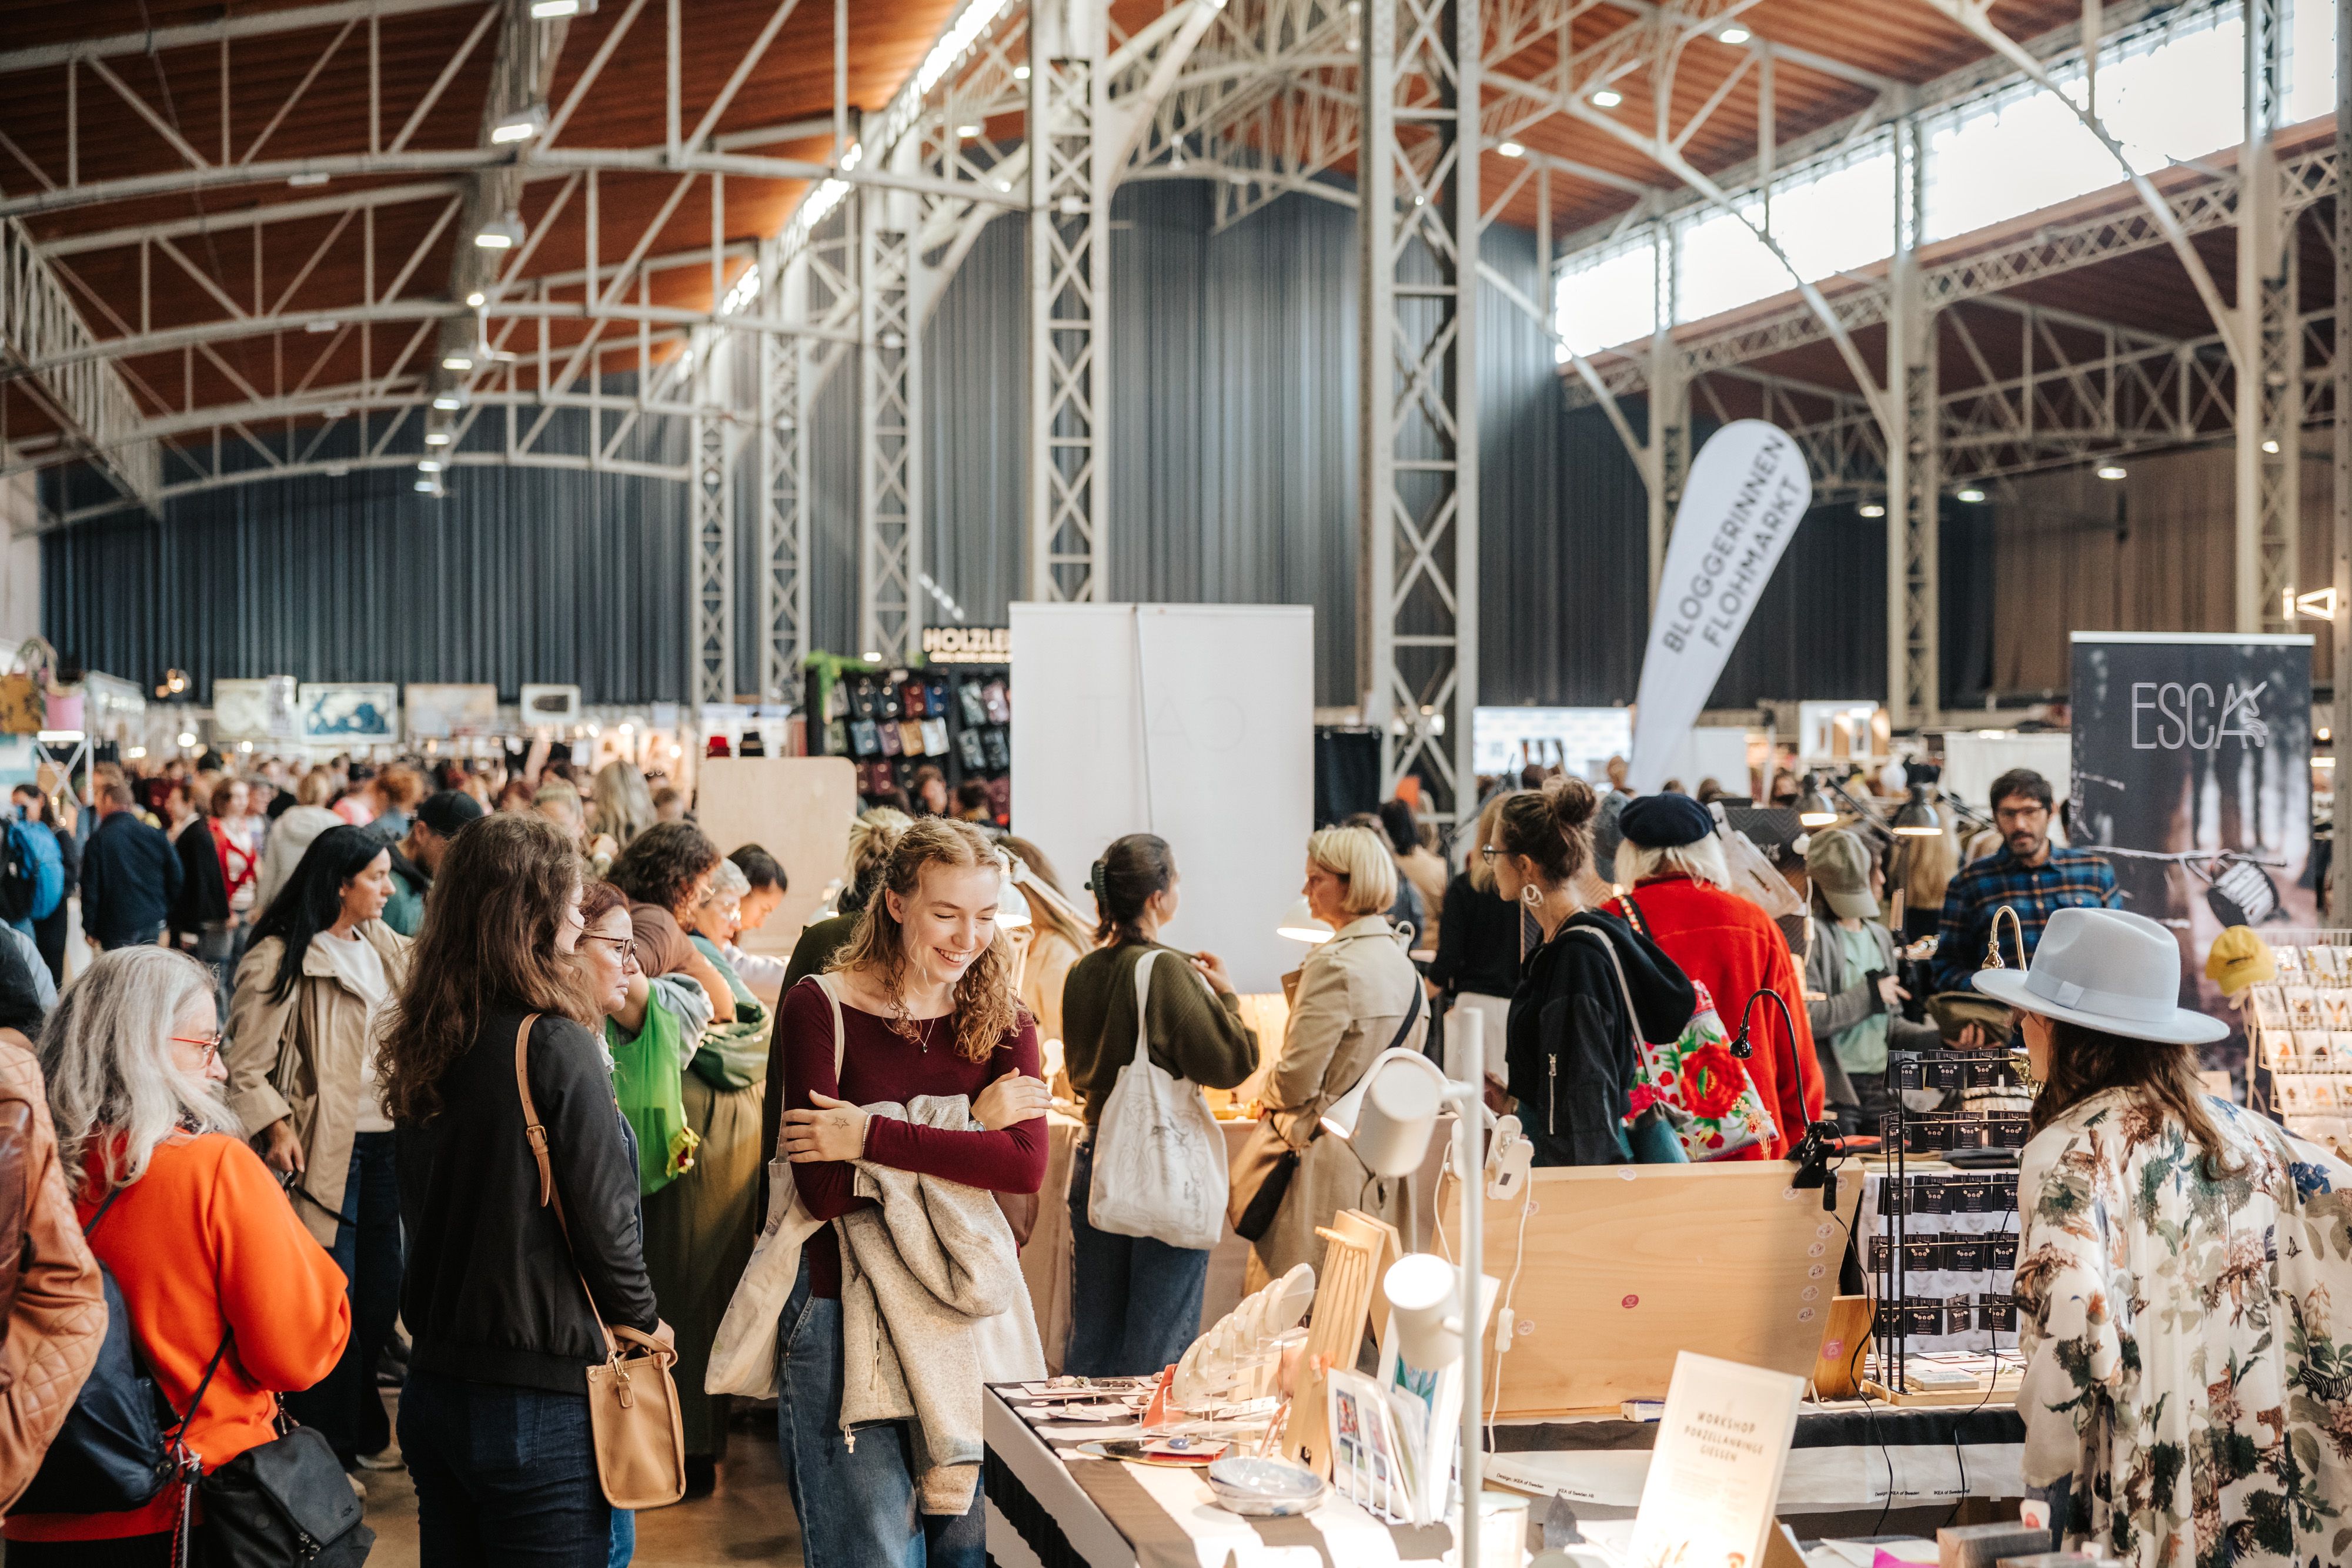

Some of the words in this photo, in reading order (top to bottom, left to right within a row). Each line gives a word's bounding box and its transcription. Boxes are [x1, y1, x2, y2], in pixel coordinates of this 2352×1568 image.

[1662, 433, 1785, 654] BLOGGERINNEN
[1702, 475, 1801, 648] FLOHMARKT
[1698, 1412, 1755, 1433] WORKSHOP
[1685, 1425, 1763, 1455] PORZELLANRINGE
[1700, 1445, 1737, 1462] GIESSEN
